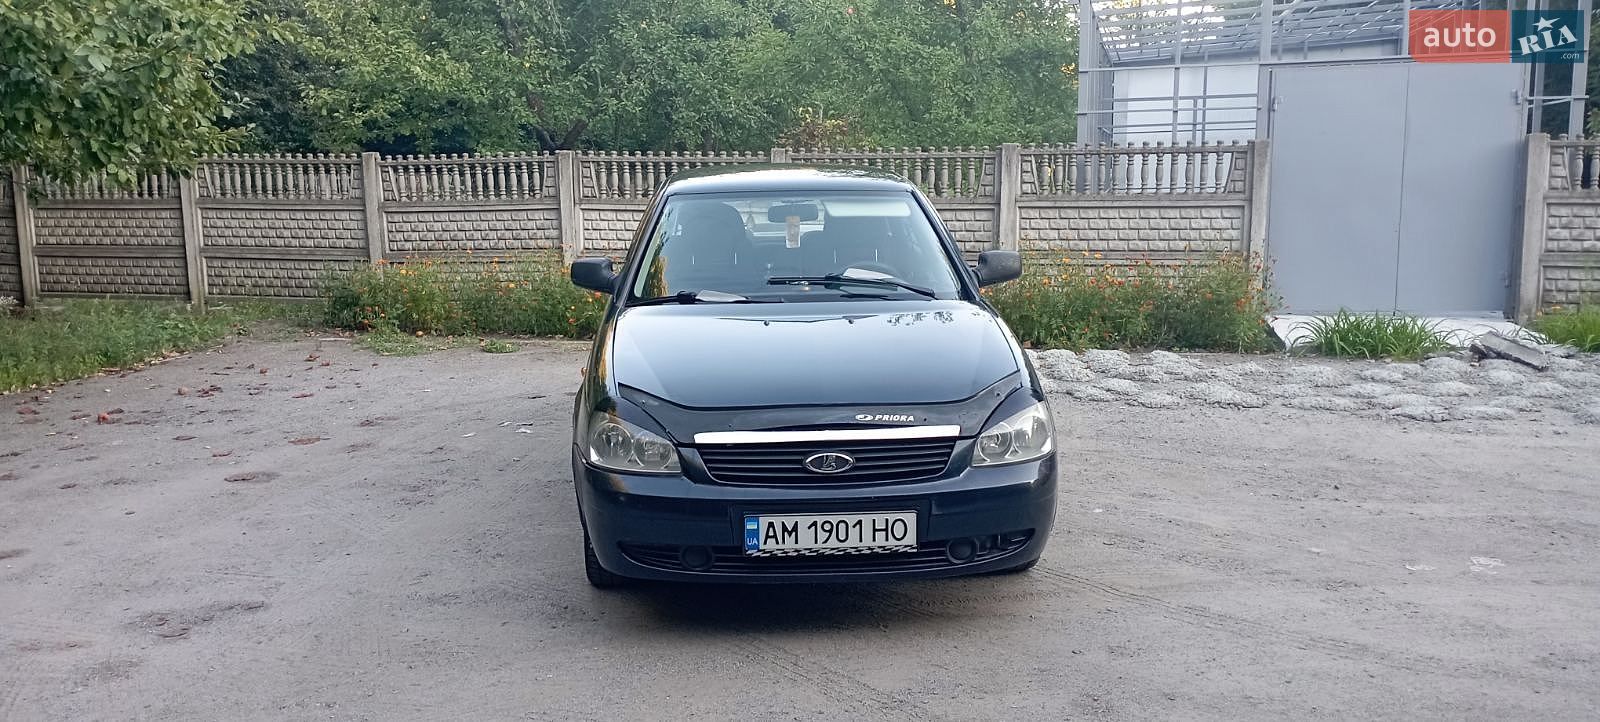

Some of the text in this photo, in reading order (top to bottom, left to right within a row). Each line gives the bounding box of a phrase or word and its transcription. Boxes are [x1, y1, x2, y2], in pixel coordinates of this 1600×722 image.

[874, 414, 915, 422] PRIORA
[763, 517, 908, 545] AM 1901 HO
